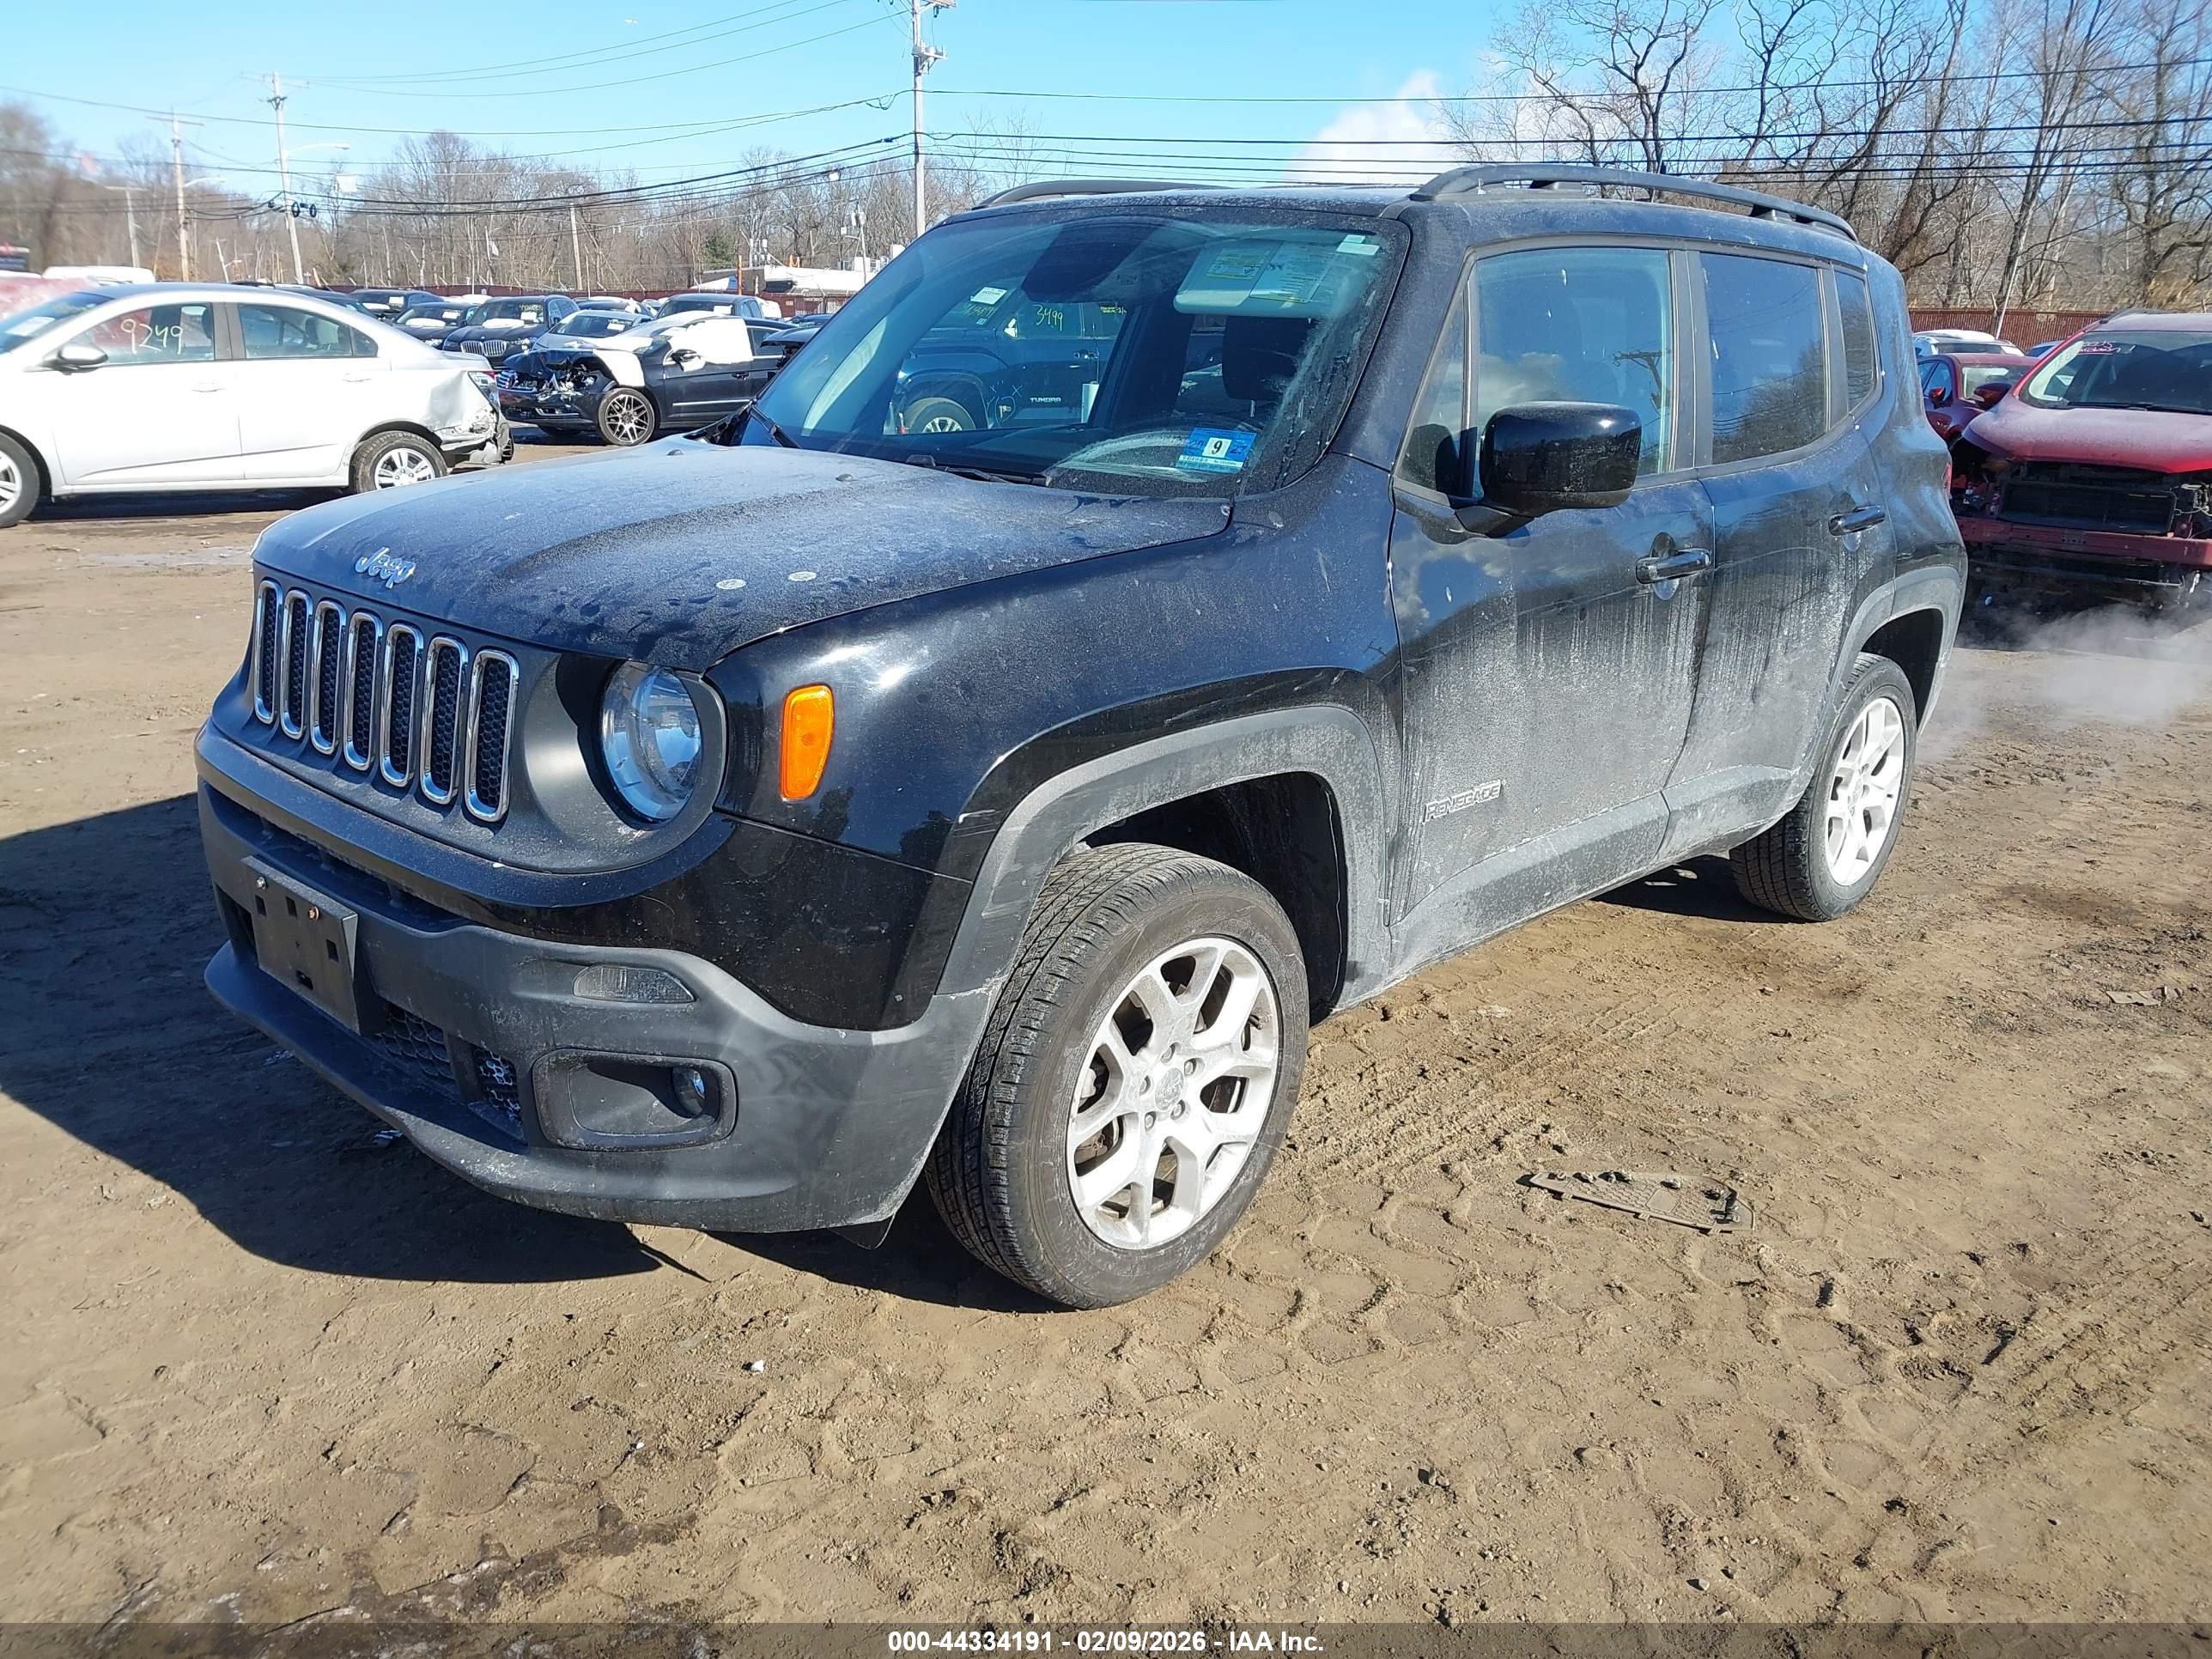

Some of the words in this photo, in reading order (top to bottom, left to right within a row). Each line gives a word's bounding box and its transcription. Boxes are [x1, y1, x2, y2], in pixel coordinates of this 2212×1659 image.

[1032, 304, 1063, 331] 3499
[120, 319, 184, 355] 9249
[1211, 440, 1223, 455] 9
[355, 545, 416, 589] Jeep
[1424, 779, 1502, 823] RENEGADE
